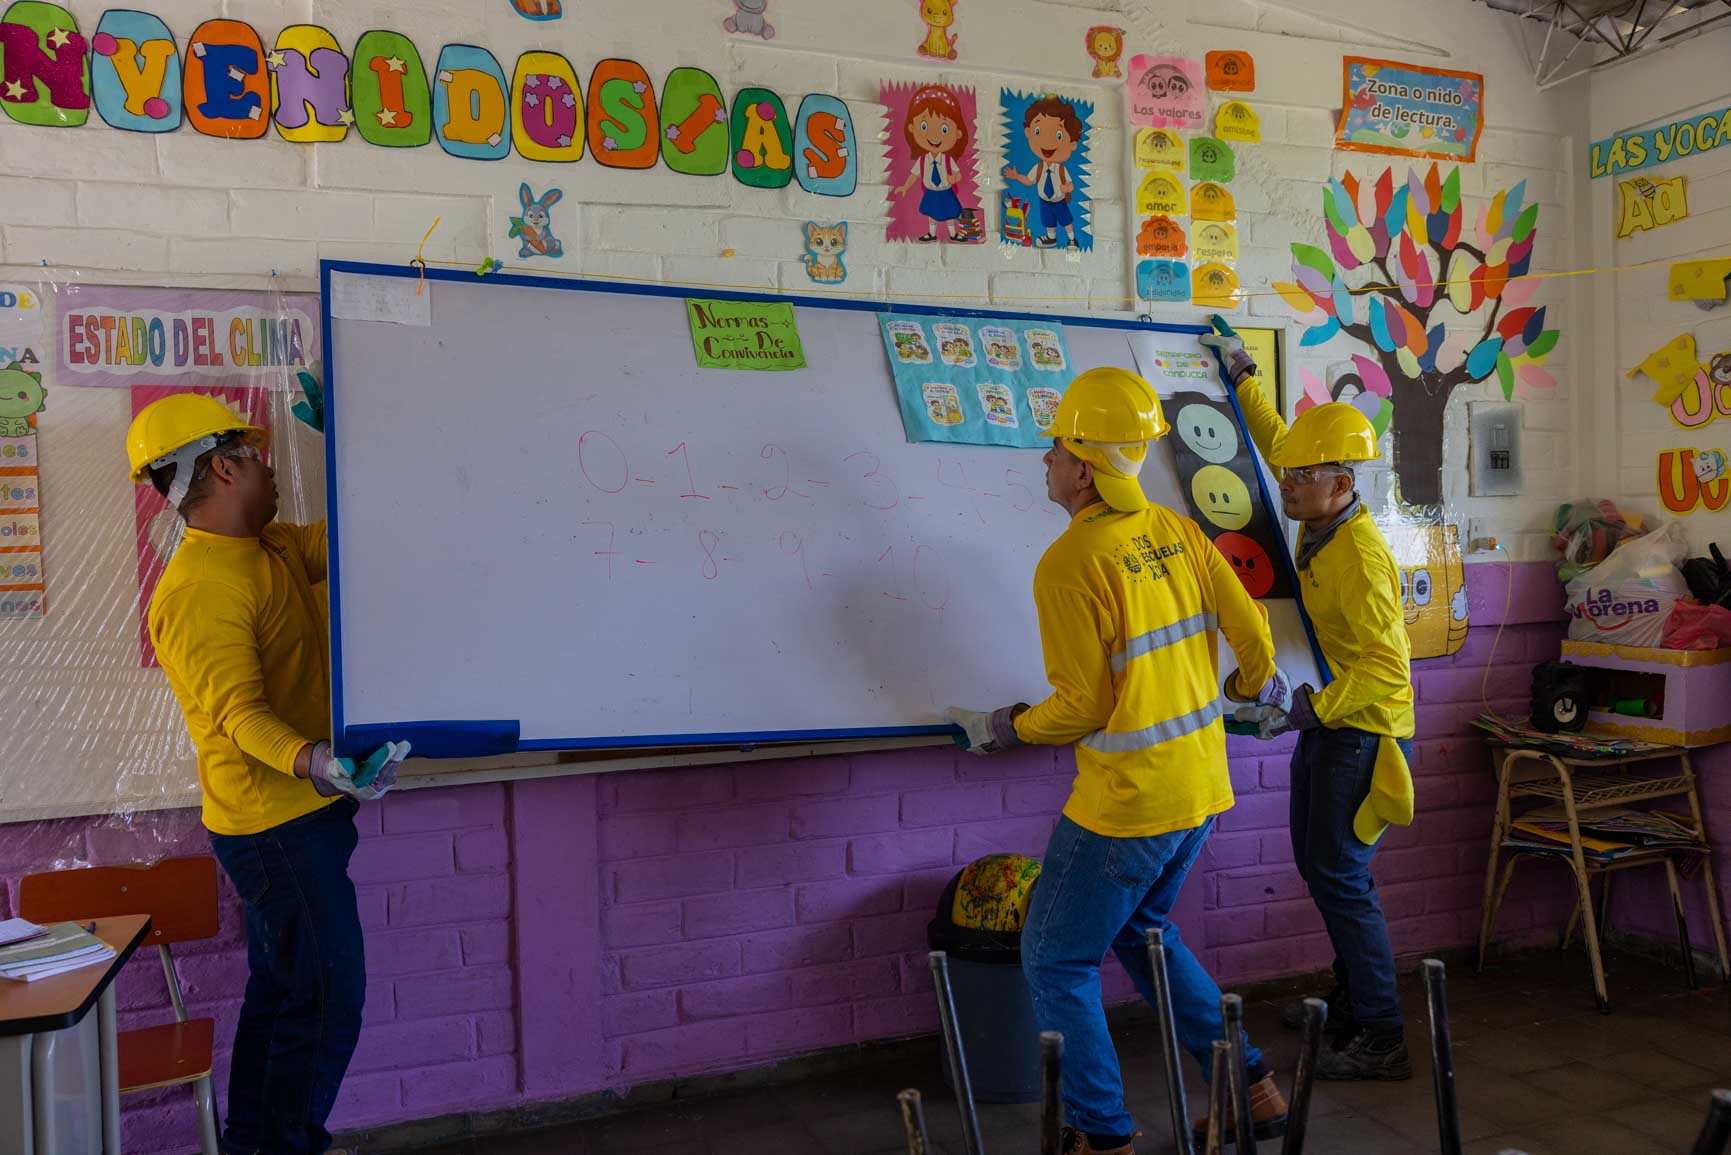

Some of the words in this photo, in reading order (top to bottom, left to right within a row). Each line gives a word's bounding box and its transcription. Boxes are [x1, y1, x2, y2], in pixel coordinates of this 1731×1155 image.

[1367, 79, 1408, 98] Zona
[1412, 88, 1423, 99] o
[1427, 88, 1462, 105] nido
[1158, 107, 1202, 120] valores
[1371, 104, 1391, 119] de
[1395, 106, 1456, 128] lectura.
[1591, 136, 1648, 178] LAS
[1146, 202, 1176, 212] amor
[1196, 247, 1232, 257] respeto
[692, 303, 769, 329] Normas
[69, 314, 166, 367] ESTADO
[173, 317, 224, 367] DEL
[229, 317, 305, 367] CLIMA
[755, 330, 784, 350] De
[1131, 534, 1152, 550] DOS
[1140, 542, 1184, 563] ESCUELAS
[1586, 587, 1612, 606] La
